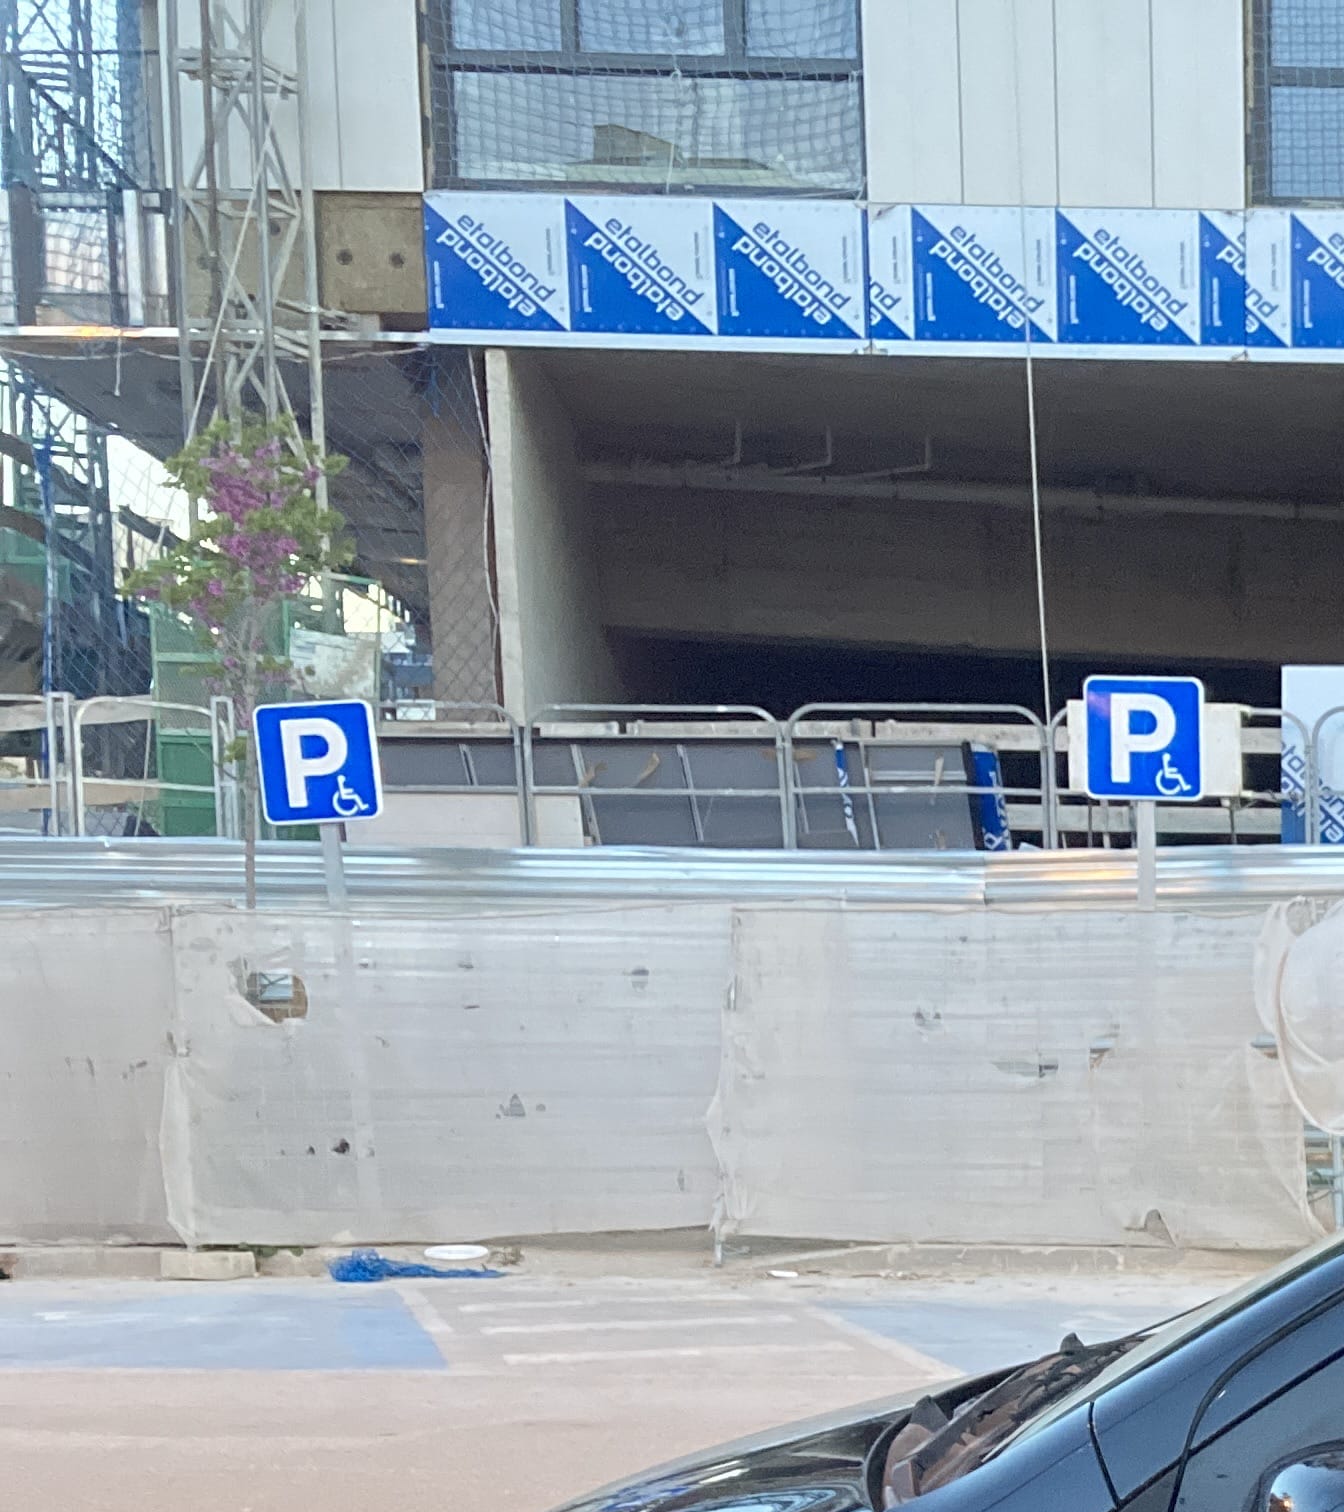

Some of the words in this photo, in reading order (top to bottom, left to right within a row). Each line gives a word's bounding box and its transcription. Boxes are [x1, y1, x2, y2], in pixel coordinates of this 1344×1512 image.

[436, 227, 537, 317] etalbond
[456, 214, 556, 303] etalbond
[583, 231, 685, 321] etalbond
[604, 217, 704, 306] etalbond
[731, 235, 832, 325] etalbond
[752, 221, 851, 310] etalbond
[928, 239, 1025, 329] etalbond
[949, 225, 1044, 314] etalbond
[1072, 241, 1169, 331] etalbond
[1093, 227, 1189, 317] etalbond
[280, 718, 348, 808] P
[1110, 693, 1176, 783] P
